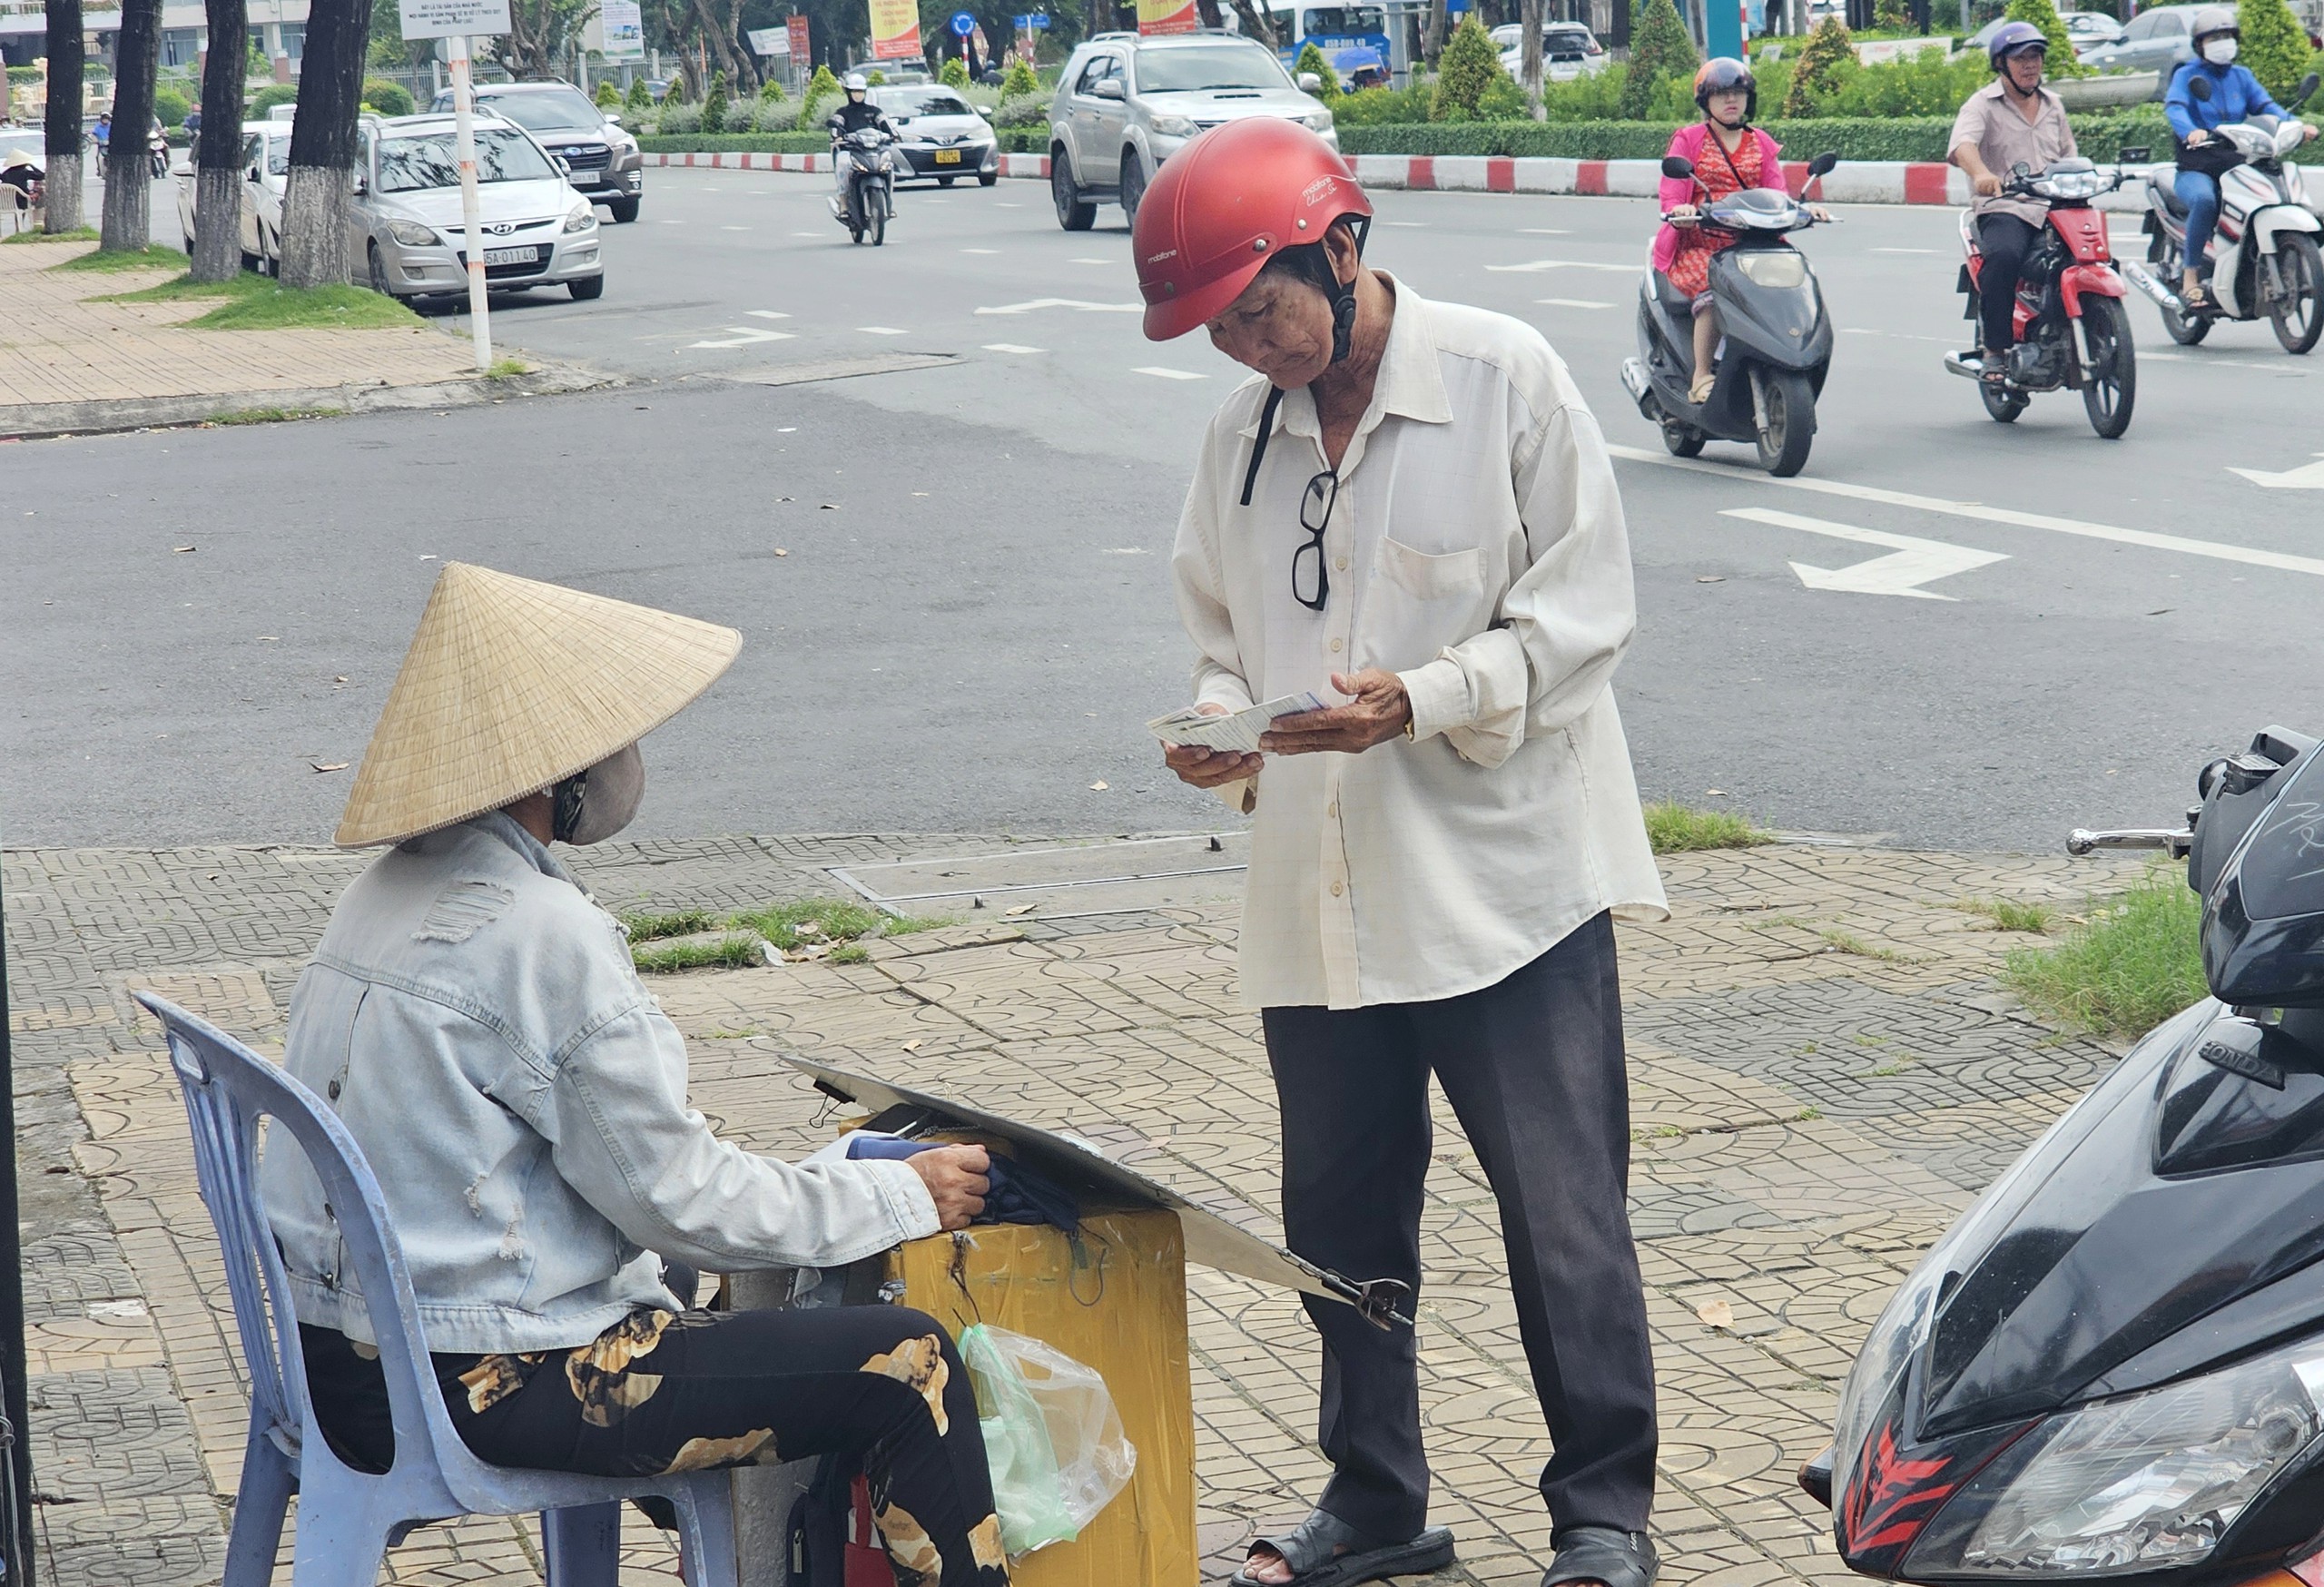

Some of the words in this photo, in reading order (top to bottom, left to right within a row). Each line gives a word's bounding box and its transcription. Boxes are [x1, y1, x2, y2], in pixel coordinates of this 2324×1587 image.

[1302, 176, 1332, 197] mobifone
[1147, 249, 1177, 264] mobifone
[2199, 1040, 2283, 1086] HONDA
